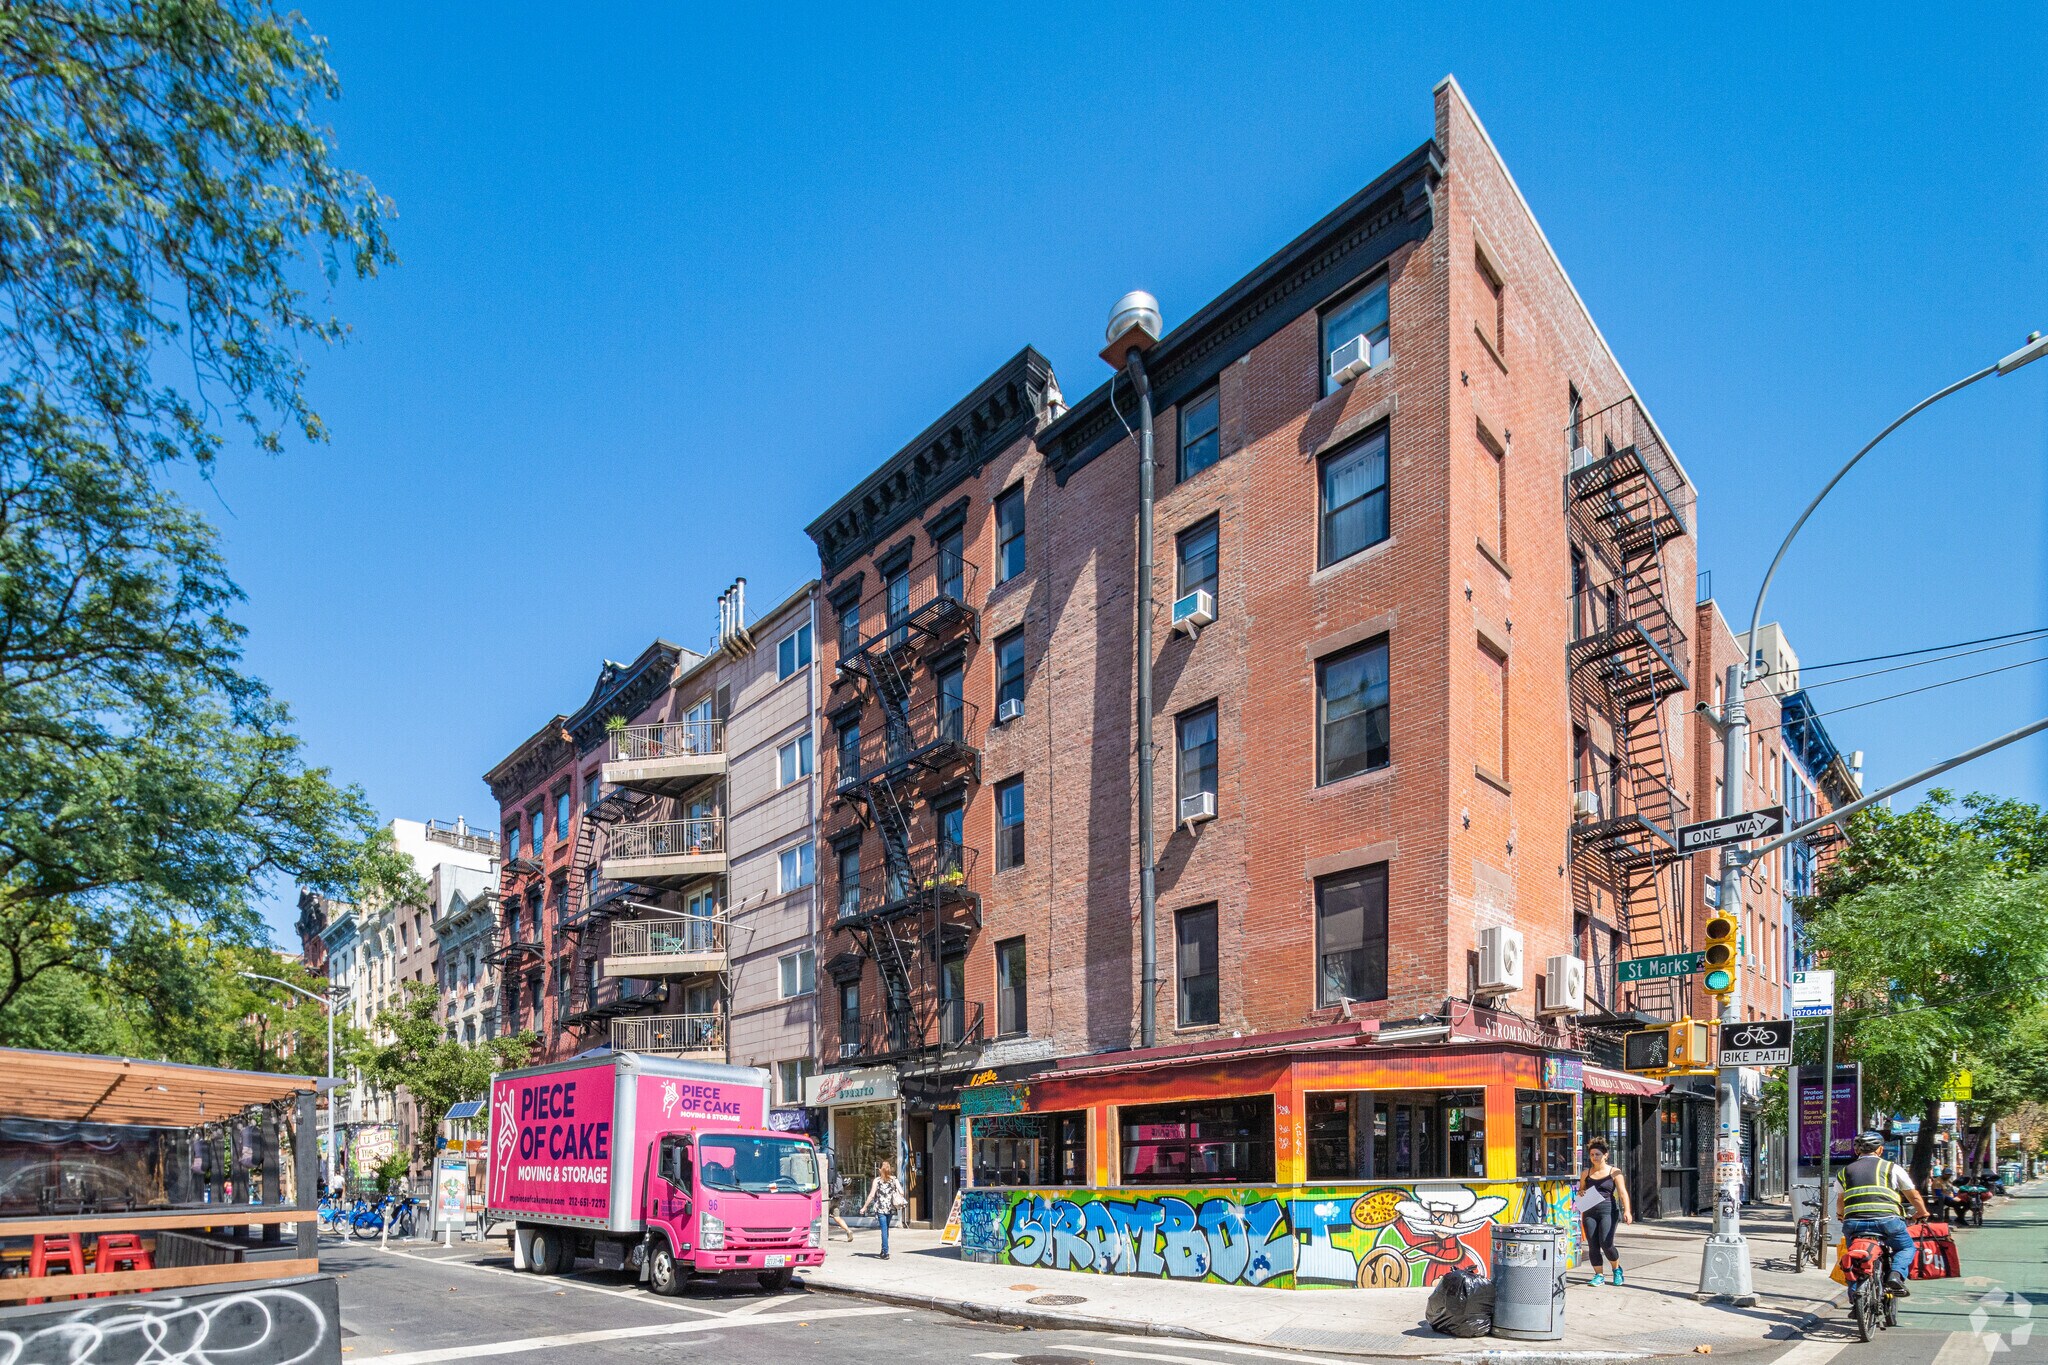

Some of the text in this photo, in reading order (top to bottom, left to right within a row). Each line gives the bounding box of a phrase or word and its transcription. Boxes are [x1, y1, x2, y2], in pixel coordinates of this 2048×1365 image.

[1692, 817, 1767, 843] ONE WAY
[1628, 959, 1690, 978] St Marks
[1795, 973, 1803, 983] 2
[1724, 1050, 1786, 1062] BIKE PATH
[682, 1085, 721, 1100] PIECE
[521, 1082, 576, 1121] PIECE
[682, 1098, 741, 1115] OF CAKE
[680, 1111, 706, 1119] MOVING
[712, 1114, 741, 1122] STORAGE
[520, 1122, 609, 1160] OF CAKE
[518, 1166, 608, 1184] MOVING & STORAGE
[568, 1197, 606, 1208] 212-651-7273
[708, 1200, 718, 1211] 96
